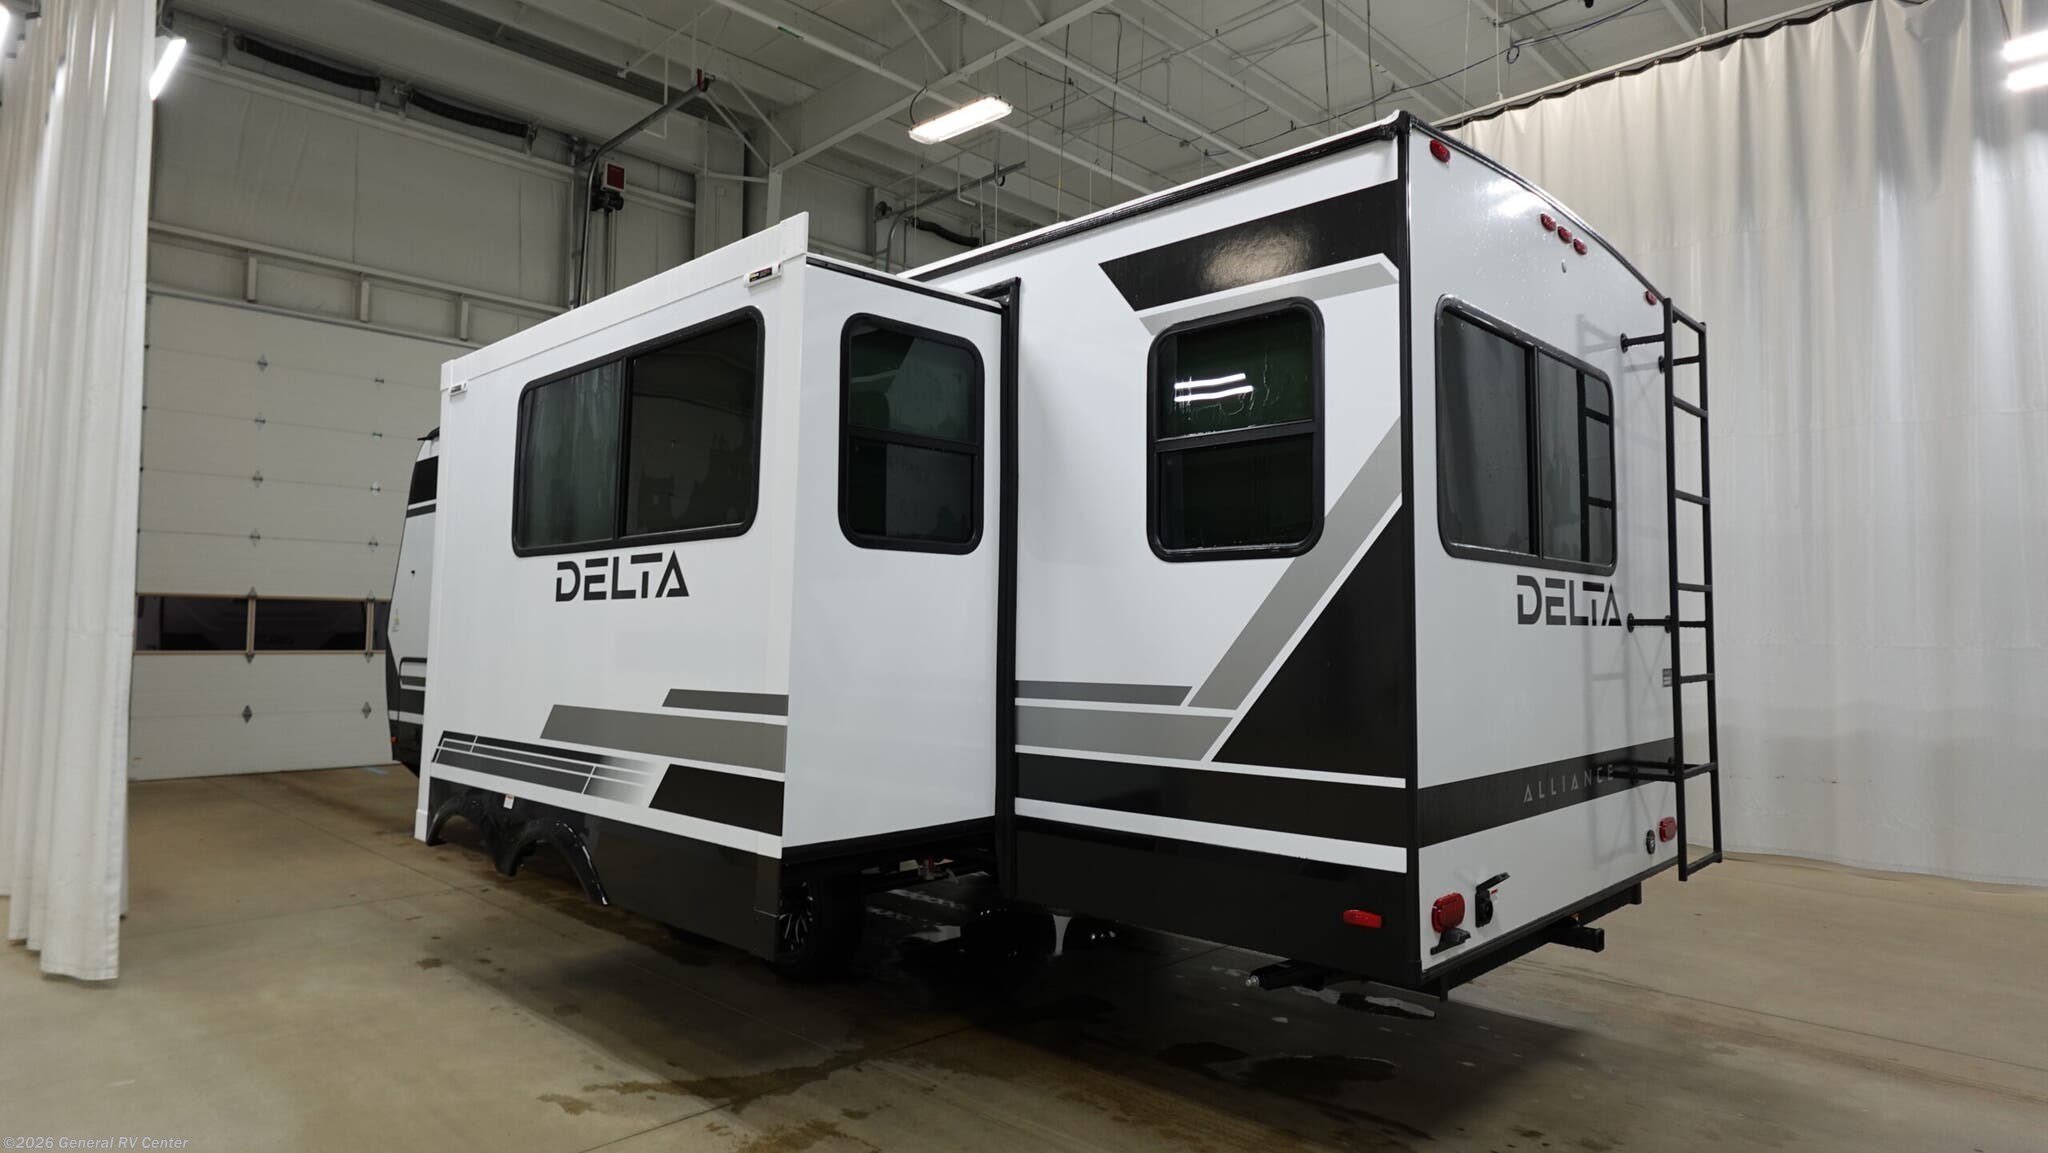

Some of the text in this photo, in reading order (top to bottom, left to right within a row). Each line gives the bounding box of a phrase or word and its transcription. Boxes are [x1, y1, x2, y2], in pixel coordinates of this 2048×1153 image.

[555, 549, 690, 602] DELTA
[1517, 574, 1622, 626] DELTA
[1523, 764, 1614, 804] ALLIANCE
